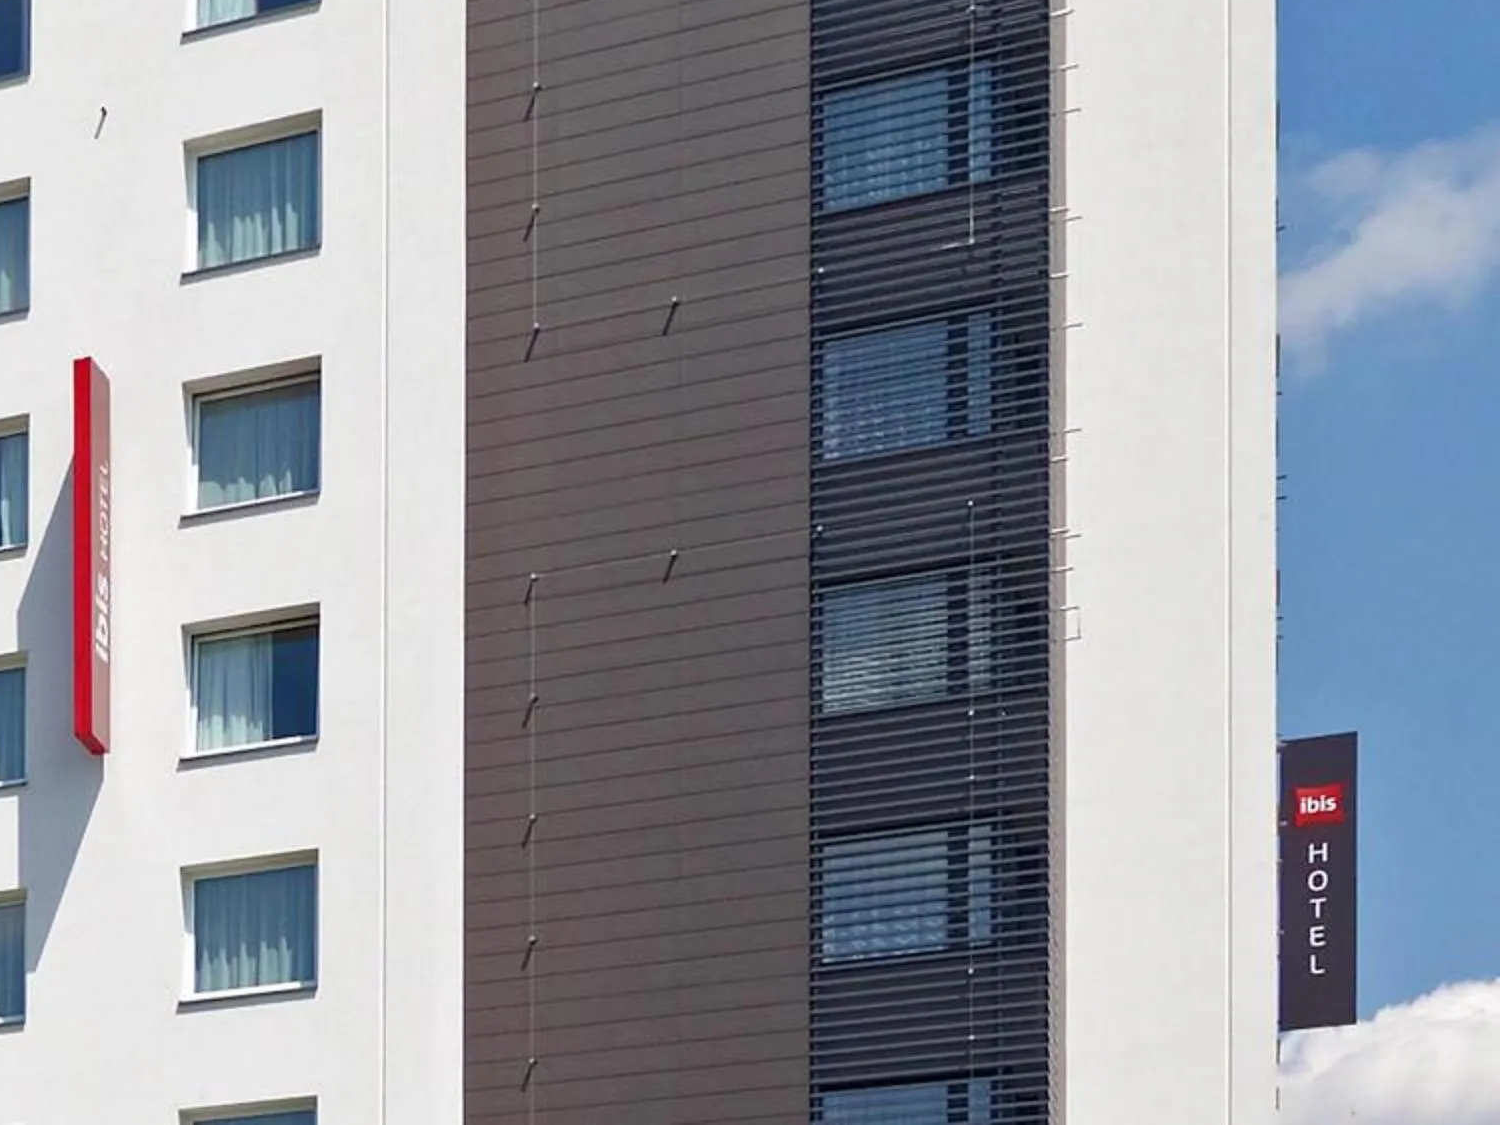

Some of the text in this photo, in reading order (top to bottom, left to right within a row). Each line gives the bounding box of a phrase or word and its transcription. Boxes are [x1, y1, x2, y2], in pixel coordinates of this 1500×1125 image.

[95, 574, 110, 664] ibis
[1299, 794, 1337, 814] ibis
[1307, 842, 1329, 975] HOTEL
